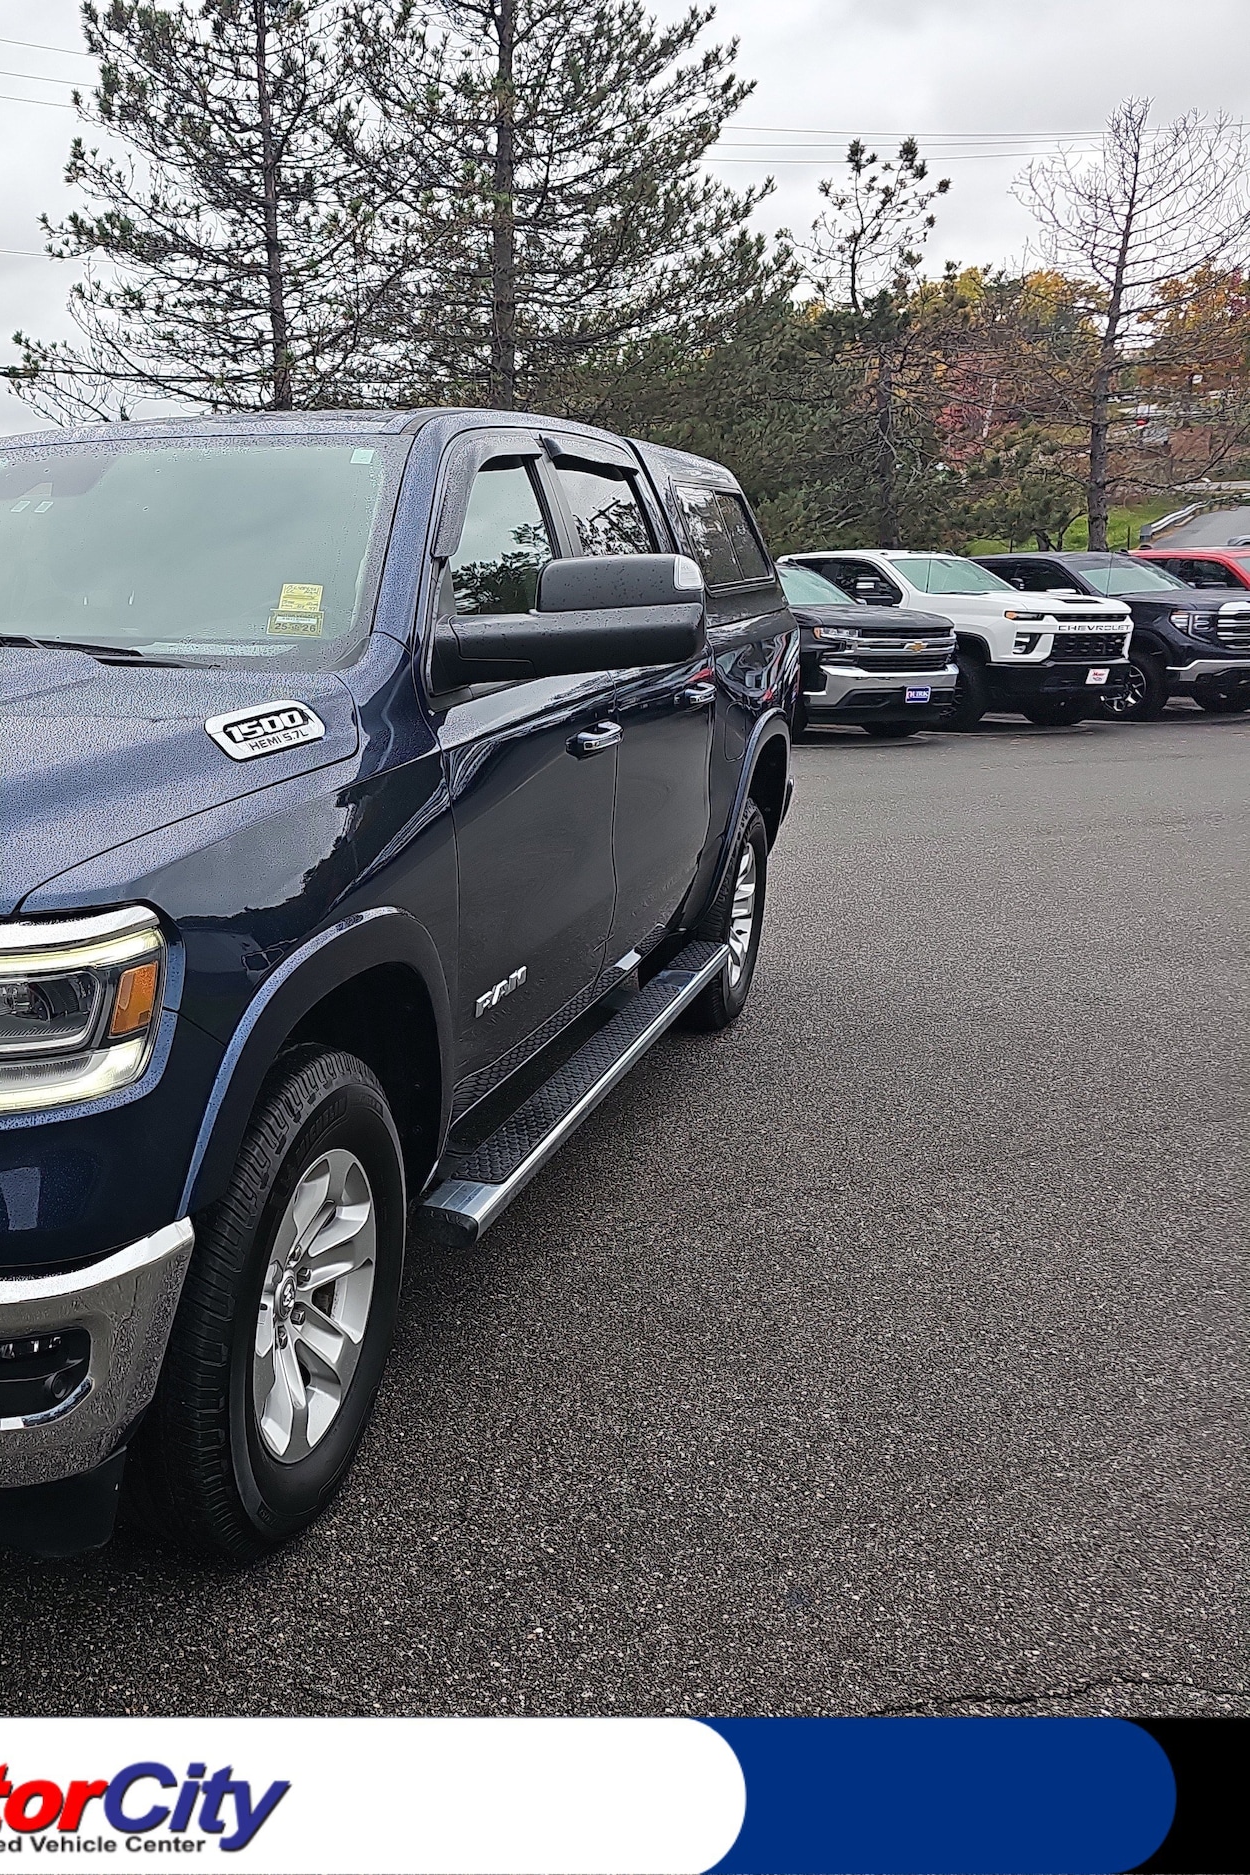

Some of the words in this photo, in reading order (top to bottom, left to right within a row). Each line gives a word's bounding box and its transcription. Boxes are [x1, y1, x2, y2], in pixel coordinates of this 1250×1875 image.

[302, 624, 317, 633] 26
[225, 709, 304, 743] 1500
[249, 735, 281, 751] HEMI
[284, 729, 309, 742] 5.7L
[475, 965, 527, 1018] RAM
